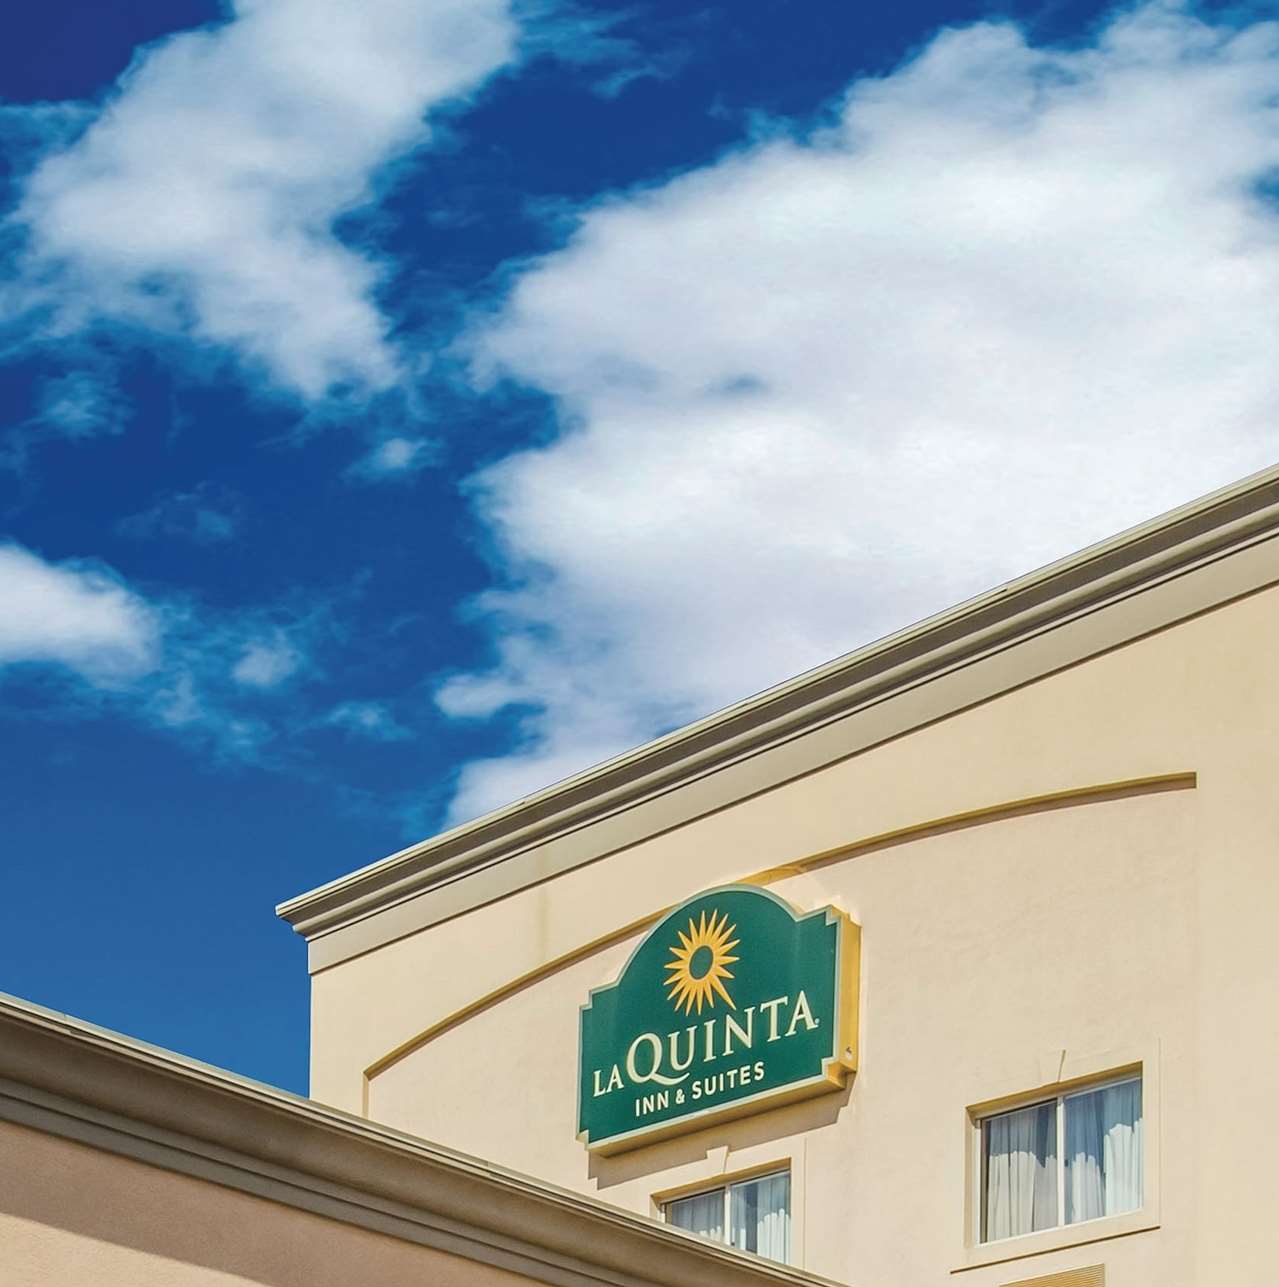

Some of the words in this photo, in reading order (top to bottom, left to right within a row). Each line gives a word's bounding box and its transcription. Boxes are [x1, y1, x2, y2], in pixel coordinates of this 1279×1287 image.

[593, 1064, 624, 1097] LA
[626, 990, 820, 1086] QUINTA
[635, 1090, 669, 1117] INN
[675, 1088, 686, 1105] &
[692, 1061, 765, 1099] SUITES
